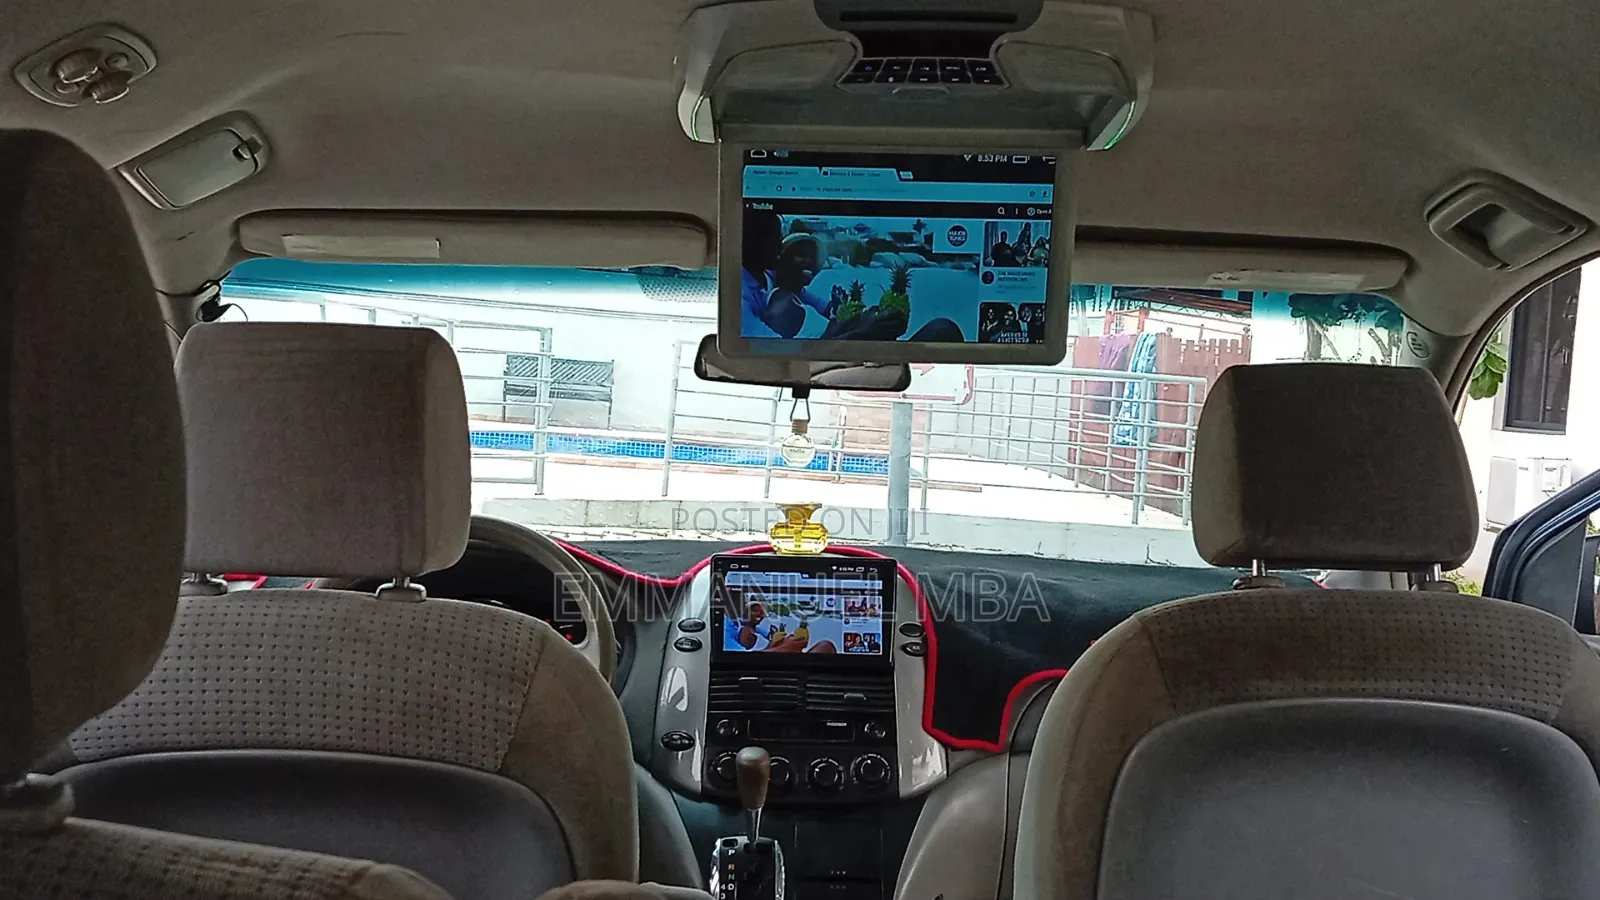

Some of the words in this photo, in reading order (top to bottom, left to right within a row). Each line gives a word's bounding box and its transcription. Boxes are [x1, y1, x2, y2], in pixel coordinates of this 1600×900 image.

[995, 154, 1008, 162] PM
[728, 873, 735, 881] N
[727, 883, 735, 891] D
